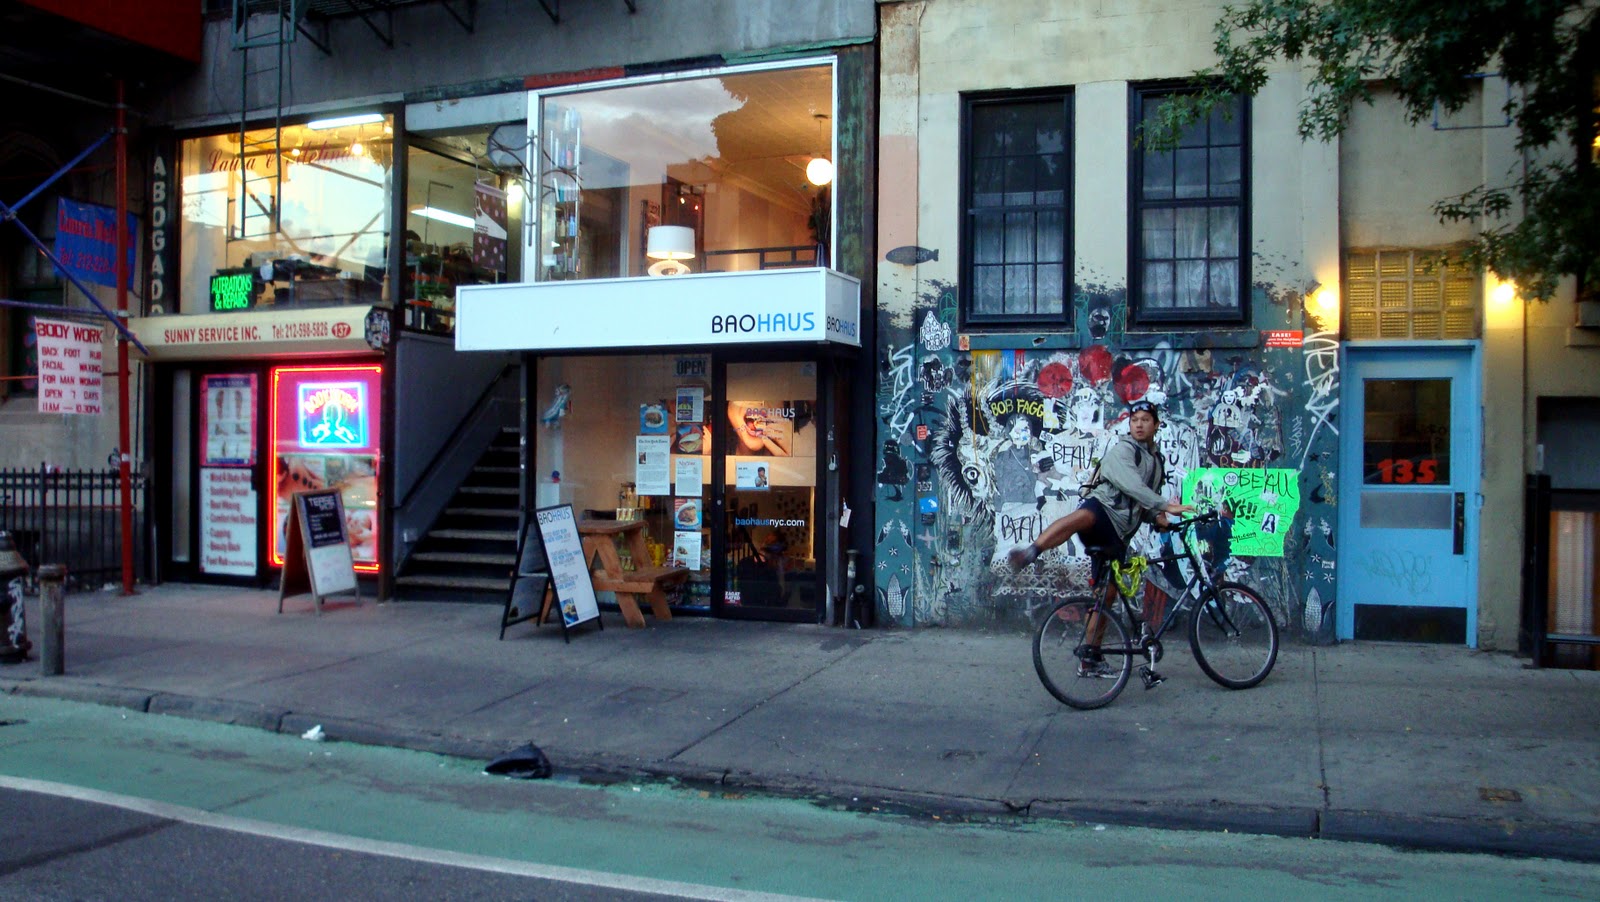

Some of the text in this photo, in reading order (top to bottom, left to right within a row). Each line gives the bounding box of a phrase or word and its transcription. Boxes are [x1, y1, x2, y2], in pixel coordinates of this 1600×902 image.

[206, 149, 256, 173] Laua
[212, 274, 252, 293] ALTERATIONS
[215, 291, 249, 310] & REPAIRS
[333, 324, 350, 338] 137
[712, 312, 815, 333] BAOHAUS
[826, 316, 856, 337] BAOHAUS
[36, 322, 103, 343] BODY WORK
[164, 326, 261, 343] SUNNY SERVICE INC.
[272, 325, 284, 338] Tel:
[42, 346, 102, 360] BACK FOOT RUB
[42, 360, 64, 370] FACIAL
[676, 360, 706, 375] OPEN
[43, 374, 101, 387] FOR MAN WOMAN
[45, 388, 63, 398] OPEN
[84, 391, 99, 400] DAYS
[43, 402, 60, 412] 11AM
[746, 408, 796, 418] BAOHAUS
[991, 399, 1014, 416] BOB
[1053, 443, 1095, 469] BEAU
[1377, 459, 1438, 483] 135
[1239, 469, 1295, 500] BEAU
[538, 508, 571, 525] BAOHAUS
[735, 517, 805, 528] baohausnyc.com
[1002, 515, 1043, 544] BEAU
